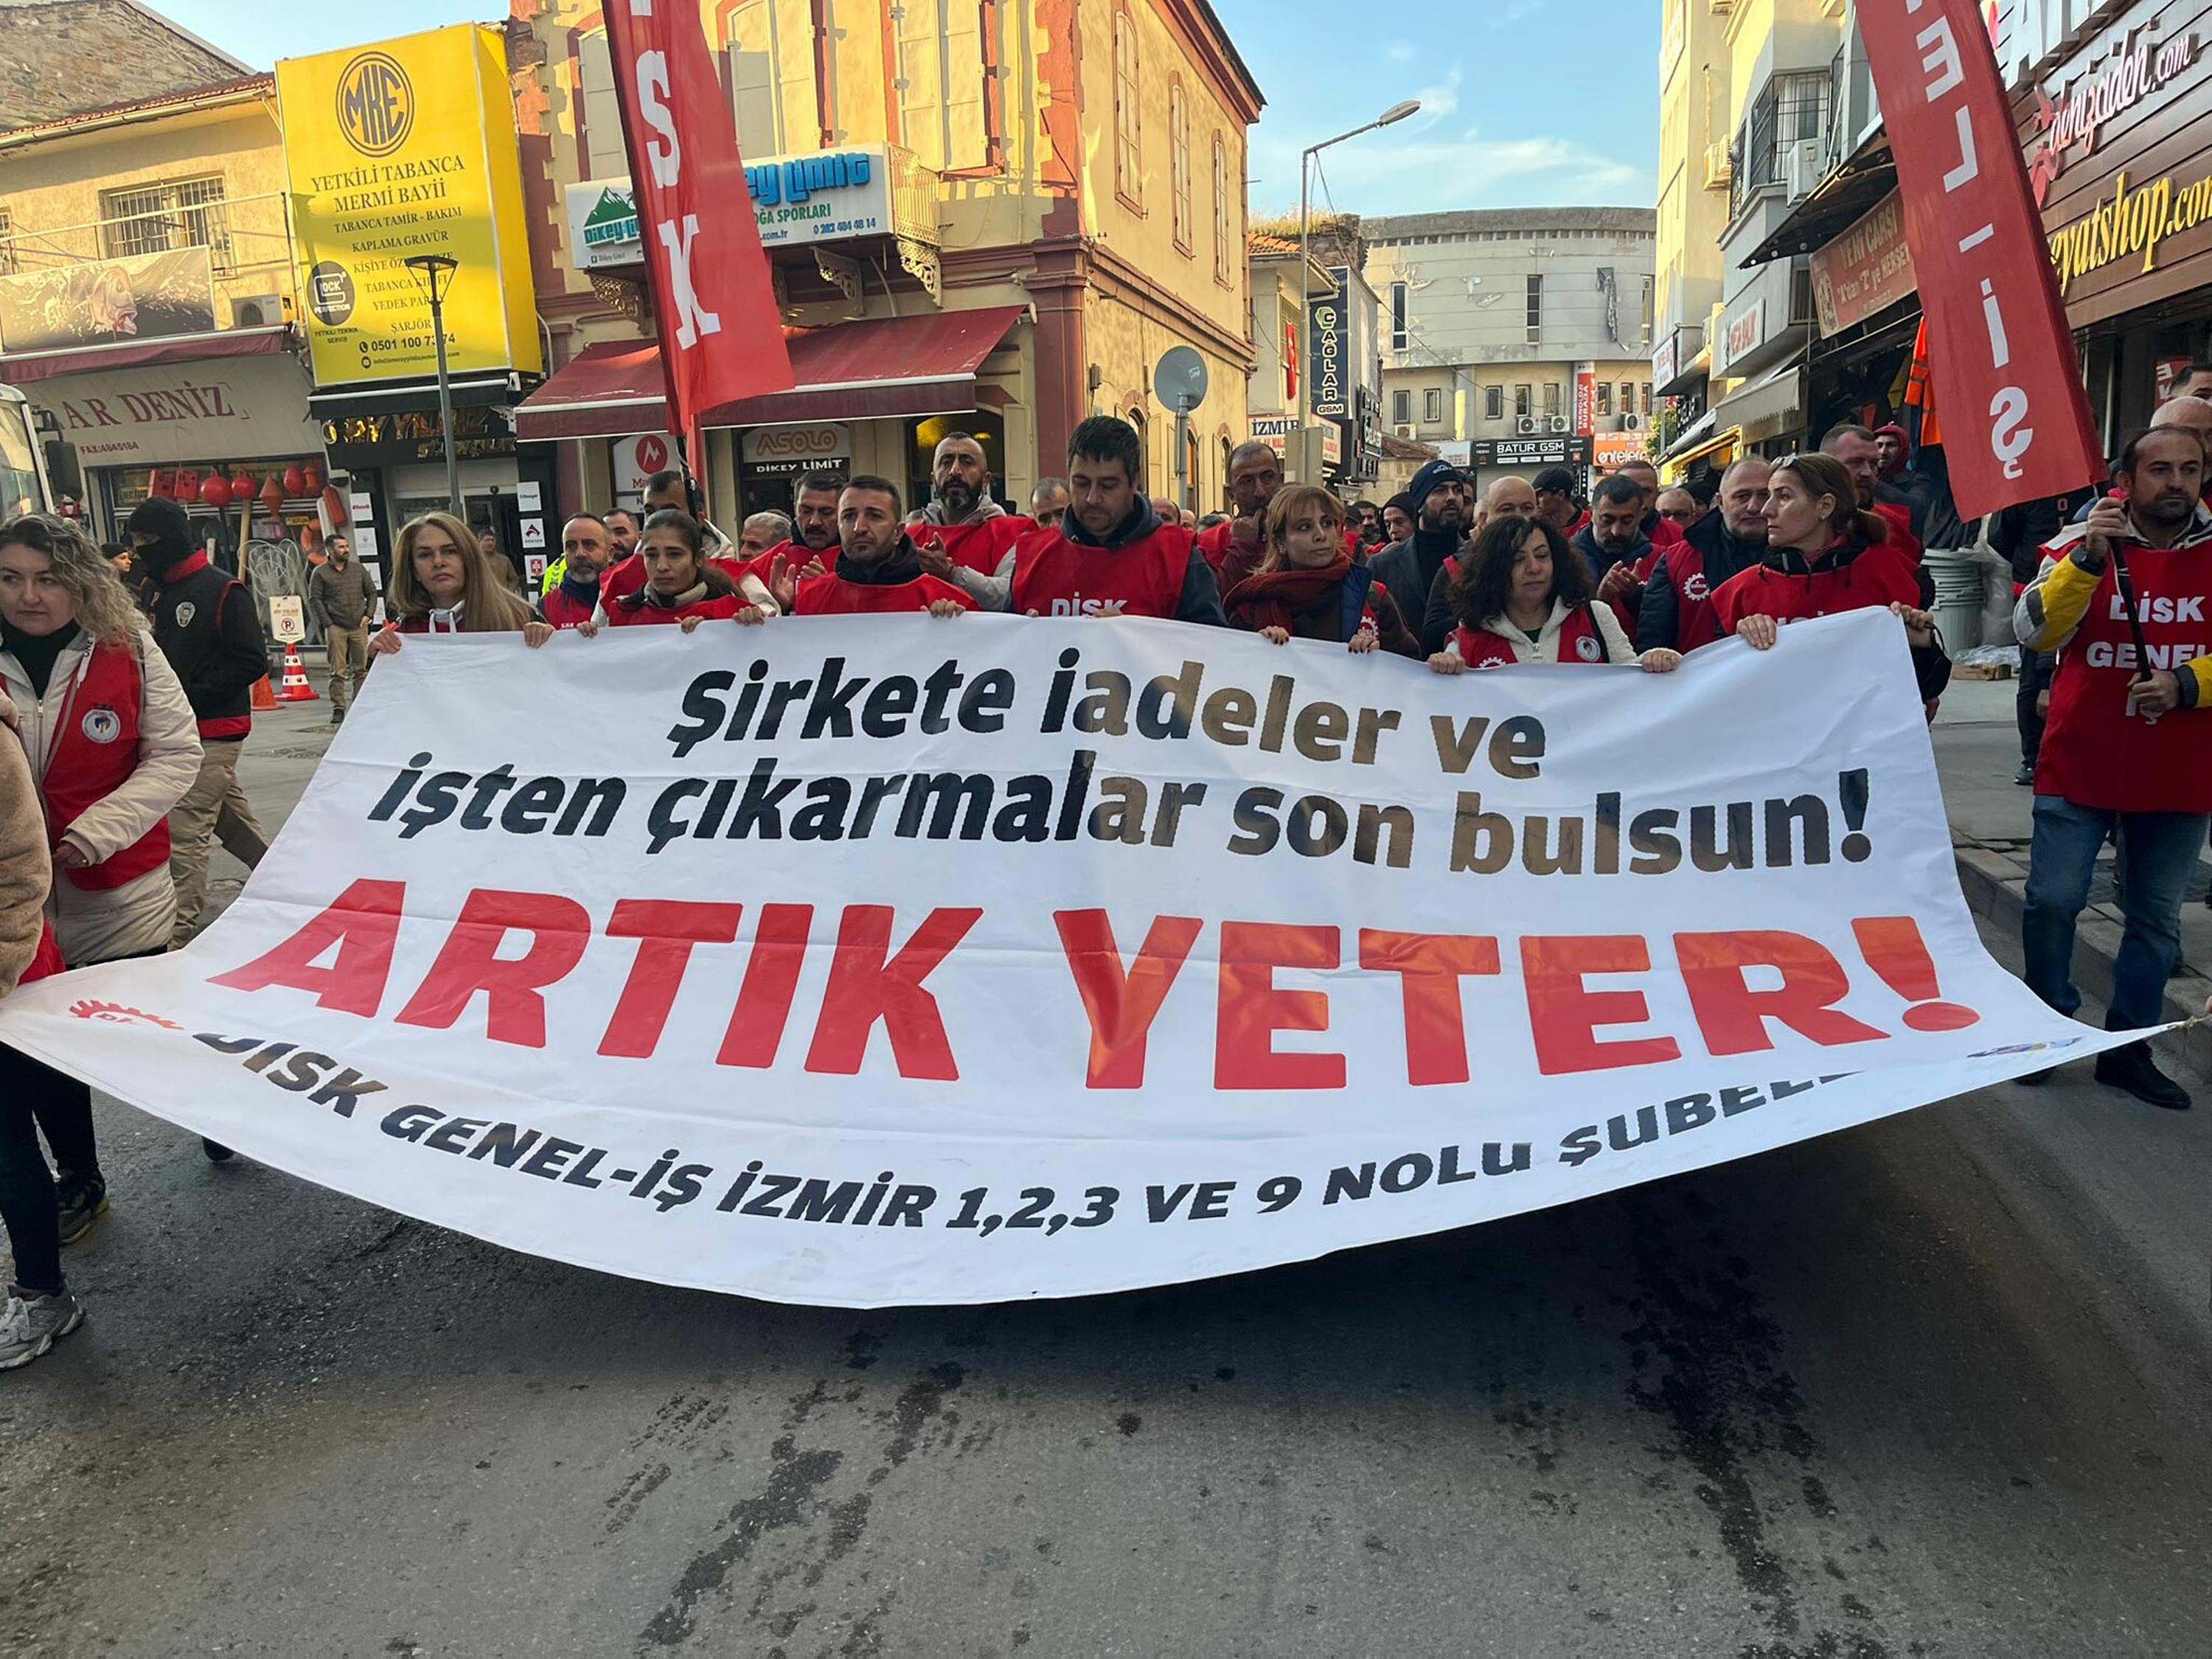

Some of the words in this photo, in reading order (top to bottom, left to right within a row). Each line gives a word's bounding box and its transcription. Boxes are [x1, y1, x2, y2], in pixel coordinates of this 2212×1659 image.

[344, 63, 405, 145] MKE
[311, 164, 378, 192] YETKİLİ
[382, 155, 466, 181] TABANCA
[333, 186, 396, 214] MERMİ
[399, 177, 447, 203] BAYİİ
[334, 217, 383, 233] TABANCA
[383, 211, 418, 226] TAMİR
[426, 206, 462, 220] BAKIM
[777, 203, 831, 222] SPORLARI
[854, 219, 864, 229] 48
[866, 218, 876, 229] 14
[352, 239, 402, 253] KAPLAMA
[404, 229, 449, 246] GRAVÜR
[353, 258, 389, 275] KİŞİYE
[365, 279, 414, 293] TABANCA
[372, 298, 408, 311] YEDEK
[390, 319, 432, 335] ŞARJÖR
[372, 340, 397, 352] 0501
[401, 336, 422, 349] 100
[118, 380, 235, 423] DENİZ
[1318, 404, 1344, 414] GSM
[757, 429, 838, 456] ASOLO
[1497, 442, 1536, 453] BATUR
[1540, 442, 1565, 452] GSM
[756, 462, 798, 473] DİKEY
[667, 657, 1016, 758] Şirkete
[1040, 647, 1402, 765] iadeler
[1429, 714, 1546, 780] ve
[367, 751, 627, 840] işten
[645, 749, 1208, 855] çıkarmalar
[1226, 786, 1415, 869] son
[1449, 767, 1872, 876] bulsun!
[205, 878, 984, 1082] ARTIK
[1054, 908, 1979, 1090] YETER!
[380, 1105, 714, 1213] GENEL-İŞ
[715, 1161, 937, 1228] İZMİR
[945, 1186, 1120, 1238] 1,2,3
[1145, 1181, 1237, 1223] VE
[1256, 1176, 1302, 1214] 9
[1322, 1142, 1532, 1206] NOLU
